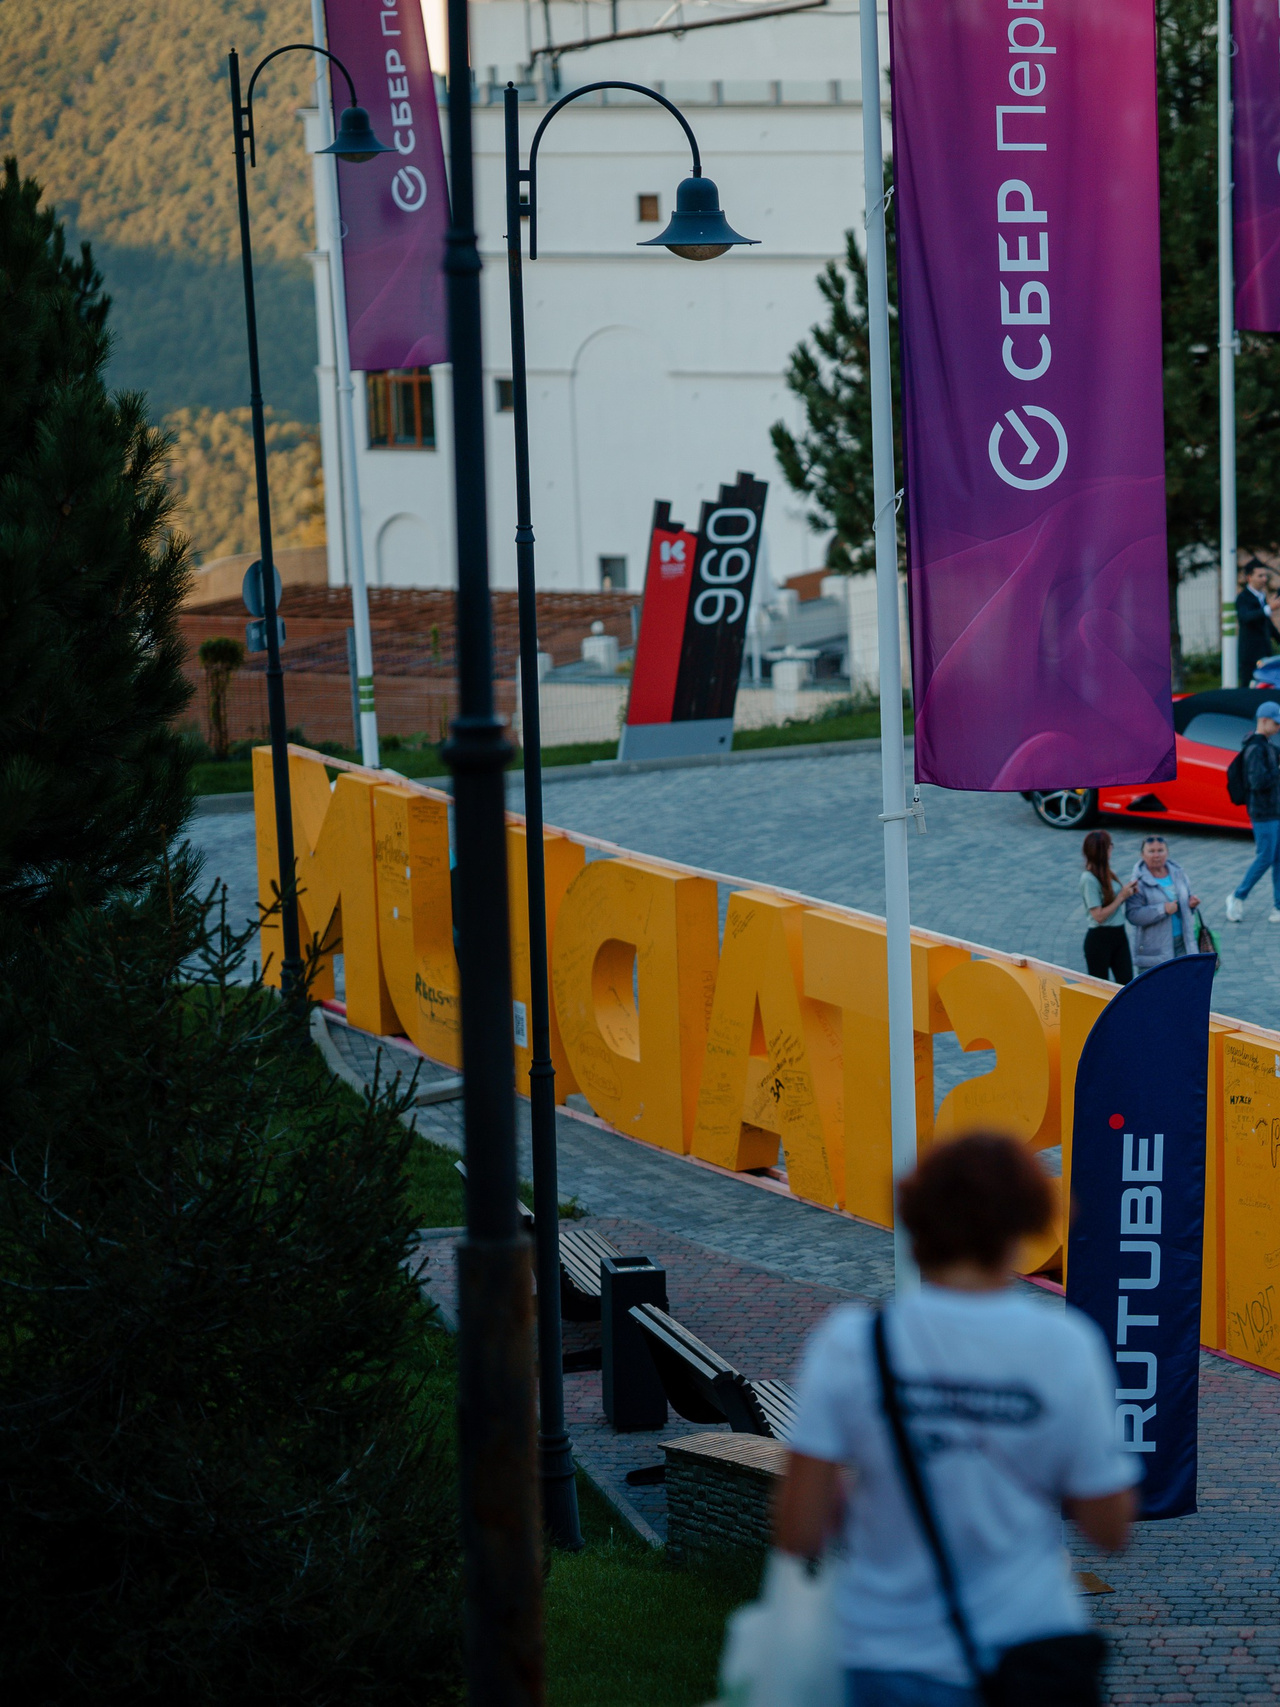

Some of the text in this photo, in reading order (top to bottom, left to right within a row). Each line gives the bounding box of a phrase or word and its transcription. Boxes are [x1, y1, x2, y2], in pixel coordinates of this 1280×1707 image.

[385, 48, 416, 156] СБЕР
[997, 178, 1053, 382] СБЕР
[693, 507, 758, 626] 960
[1115, 1132, 1165, 1453] RUTUBE
